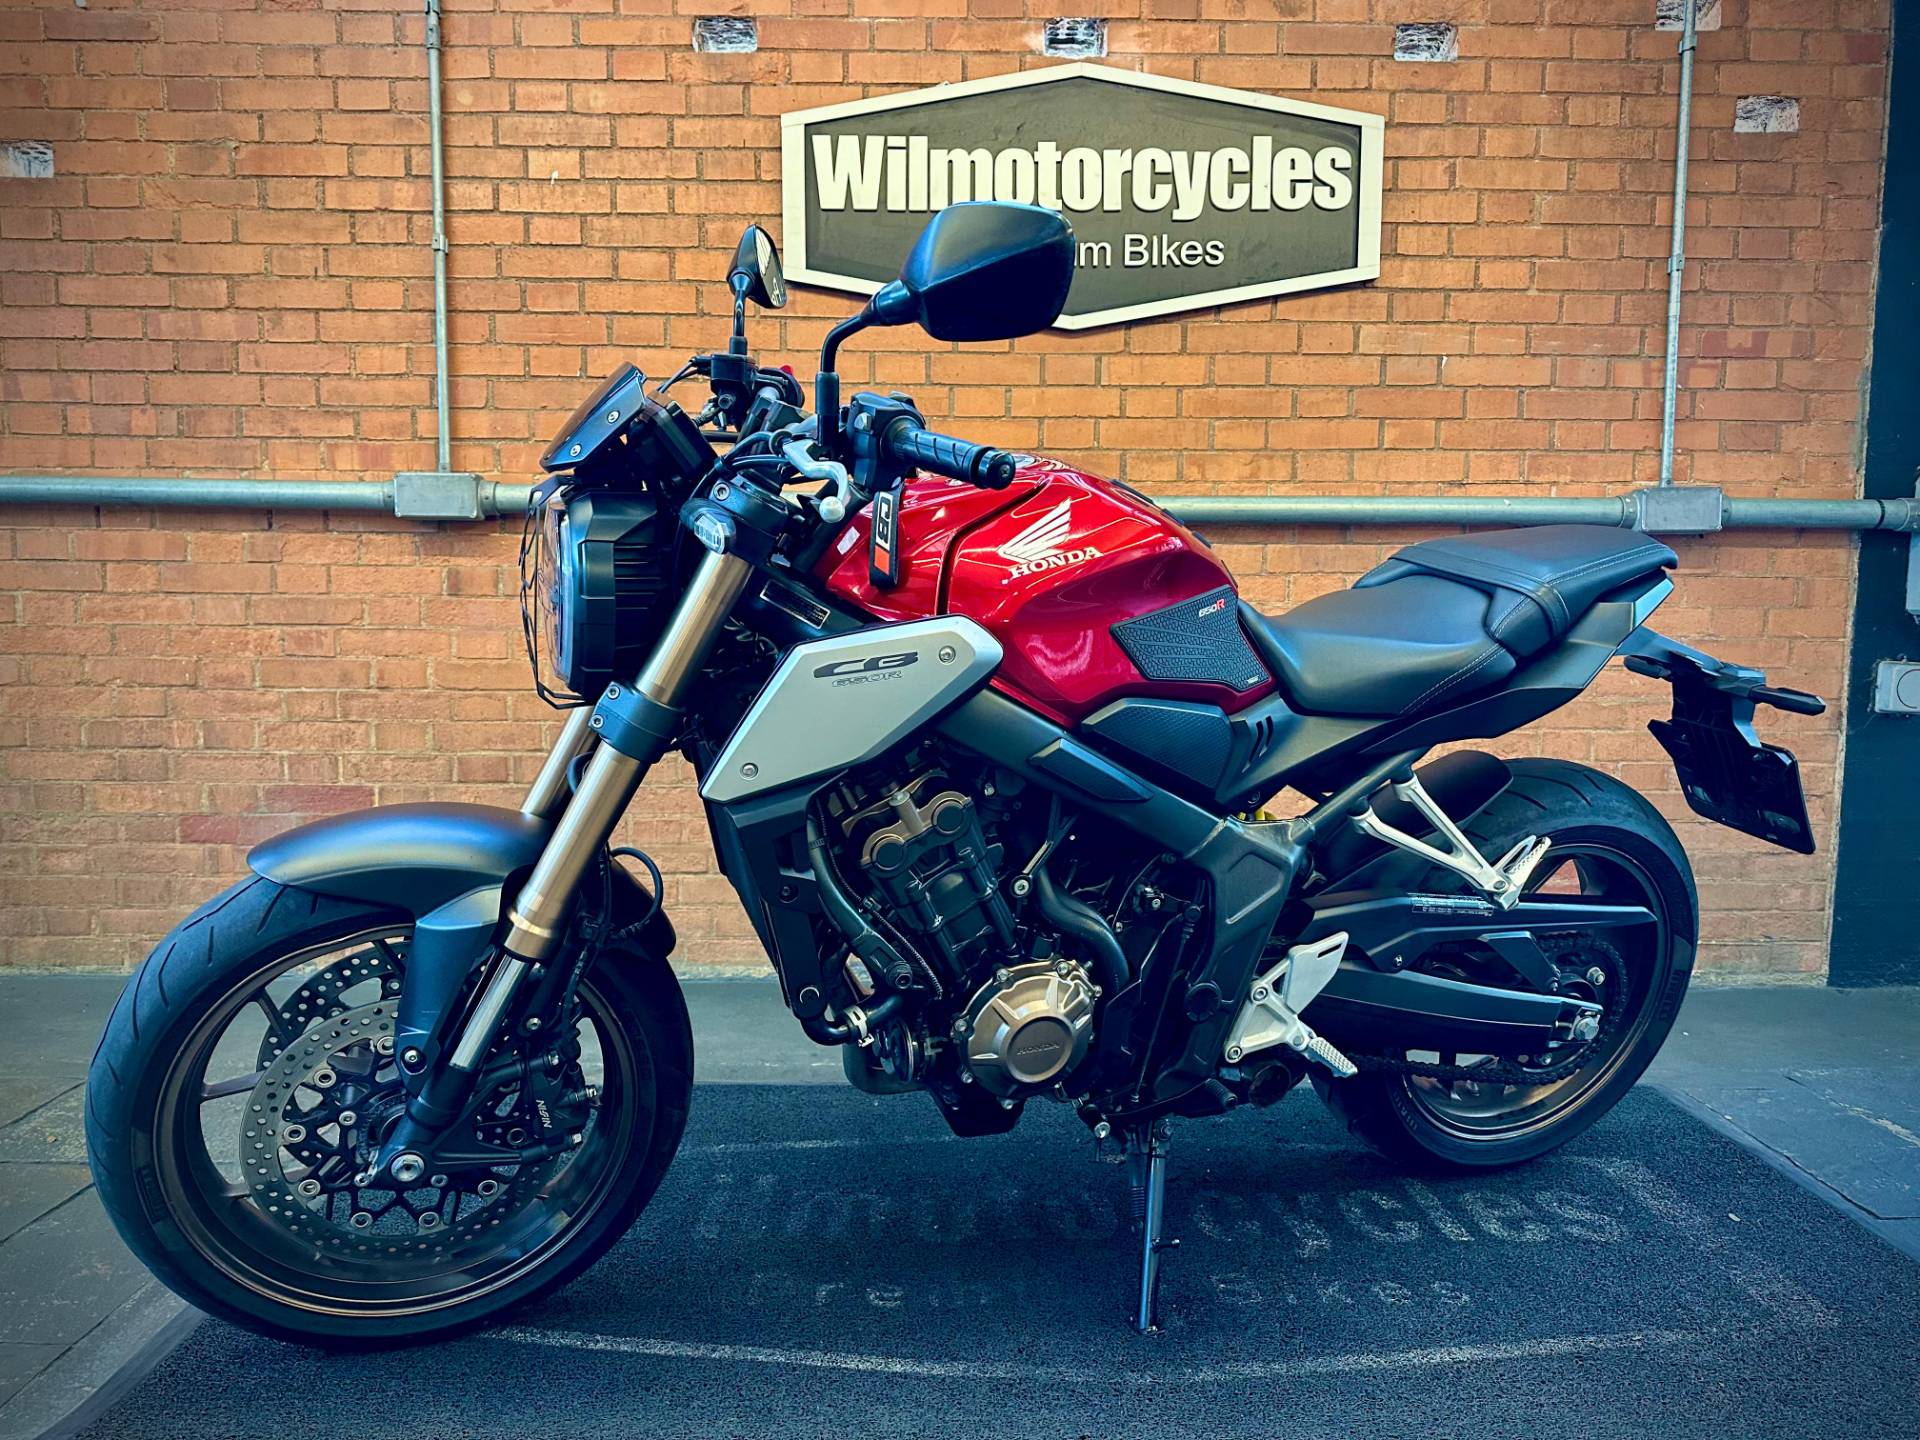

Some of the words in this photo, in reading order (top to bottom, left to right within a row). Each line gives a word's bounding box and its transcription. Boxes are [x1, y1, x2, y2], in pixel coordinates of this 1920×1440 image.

[811, 133, 1354, 222] Wilmotorcycles
[1008, 546, 1104, 580] HONDA
[1198, 598, 1226, 618] 650R
